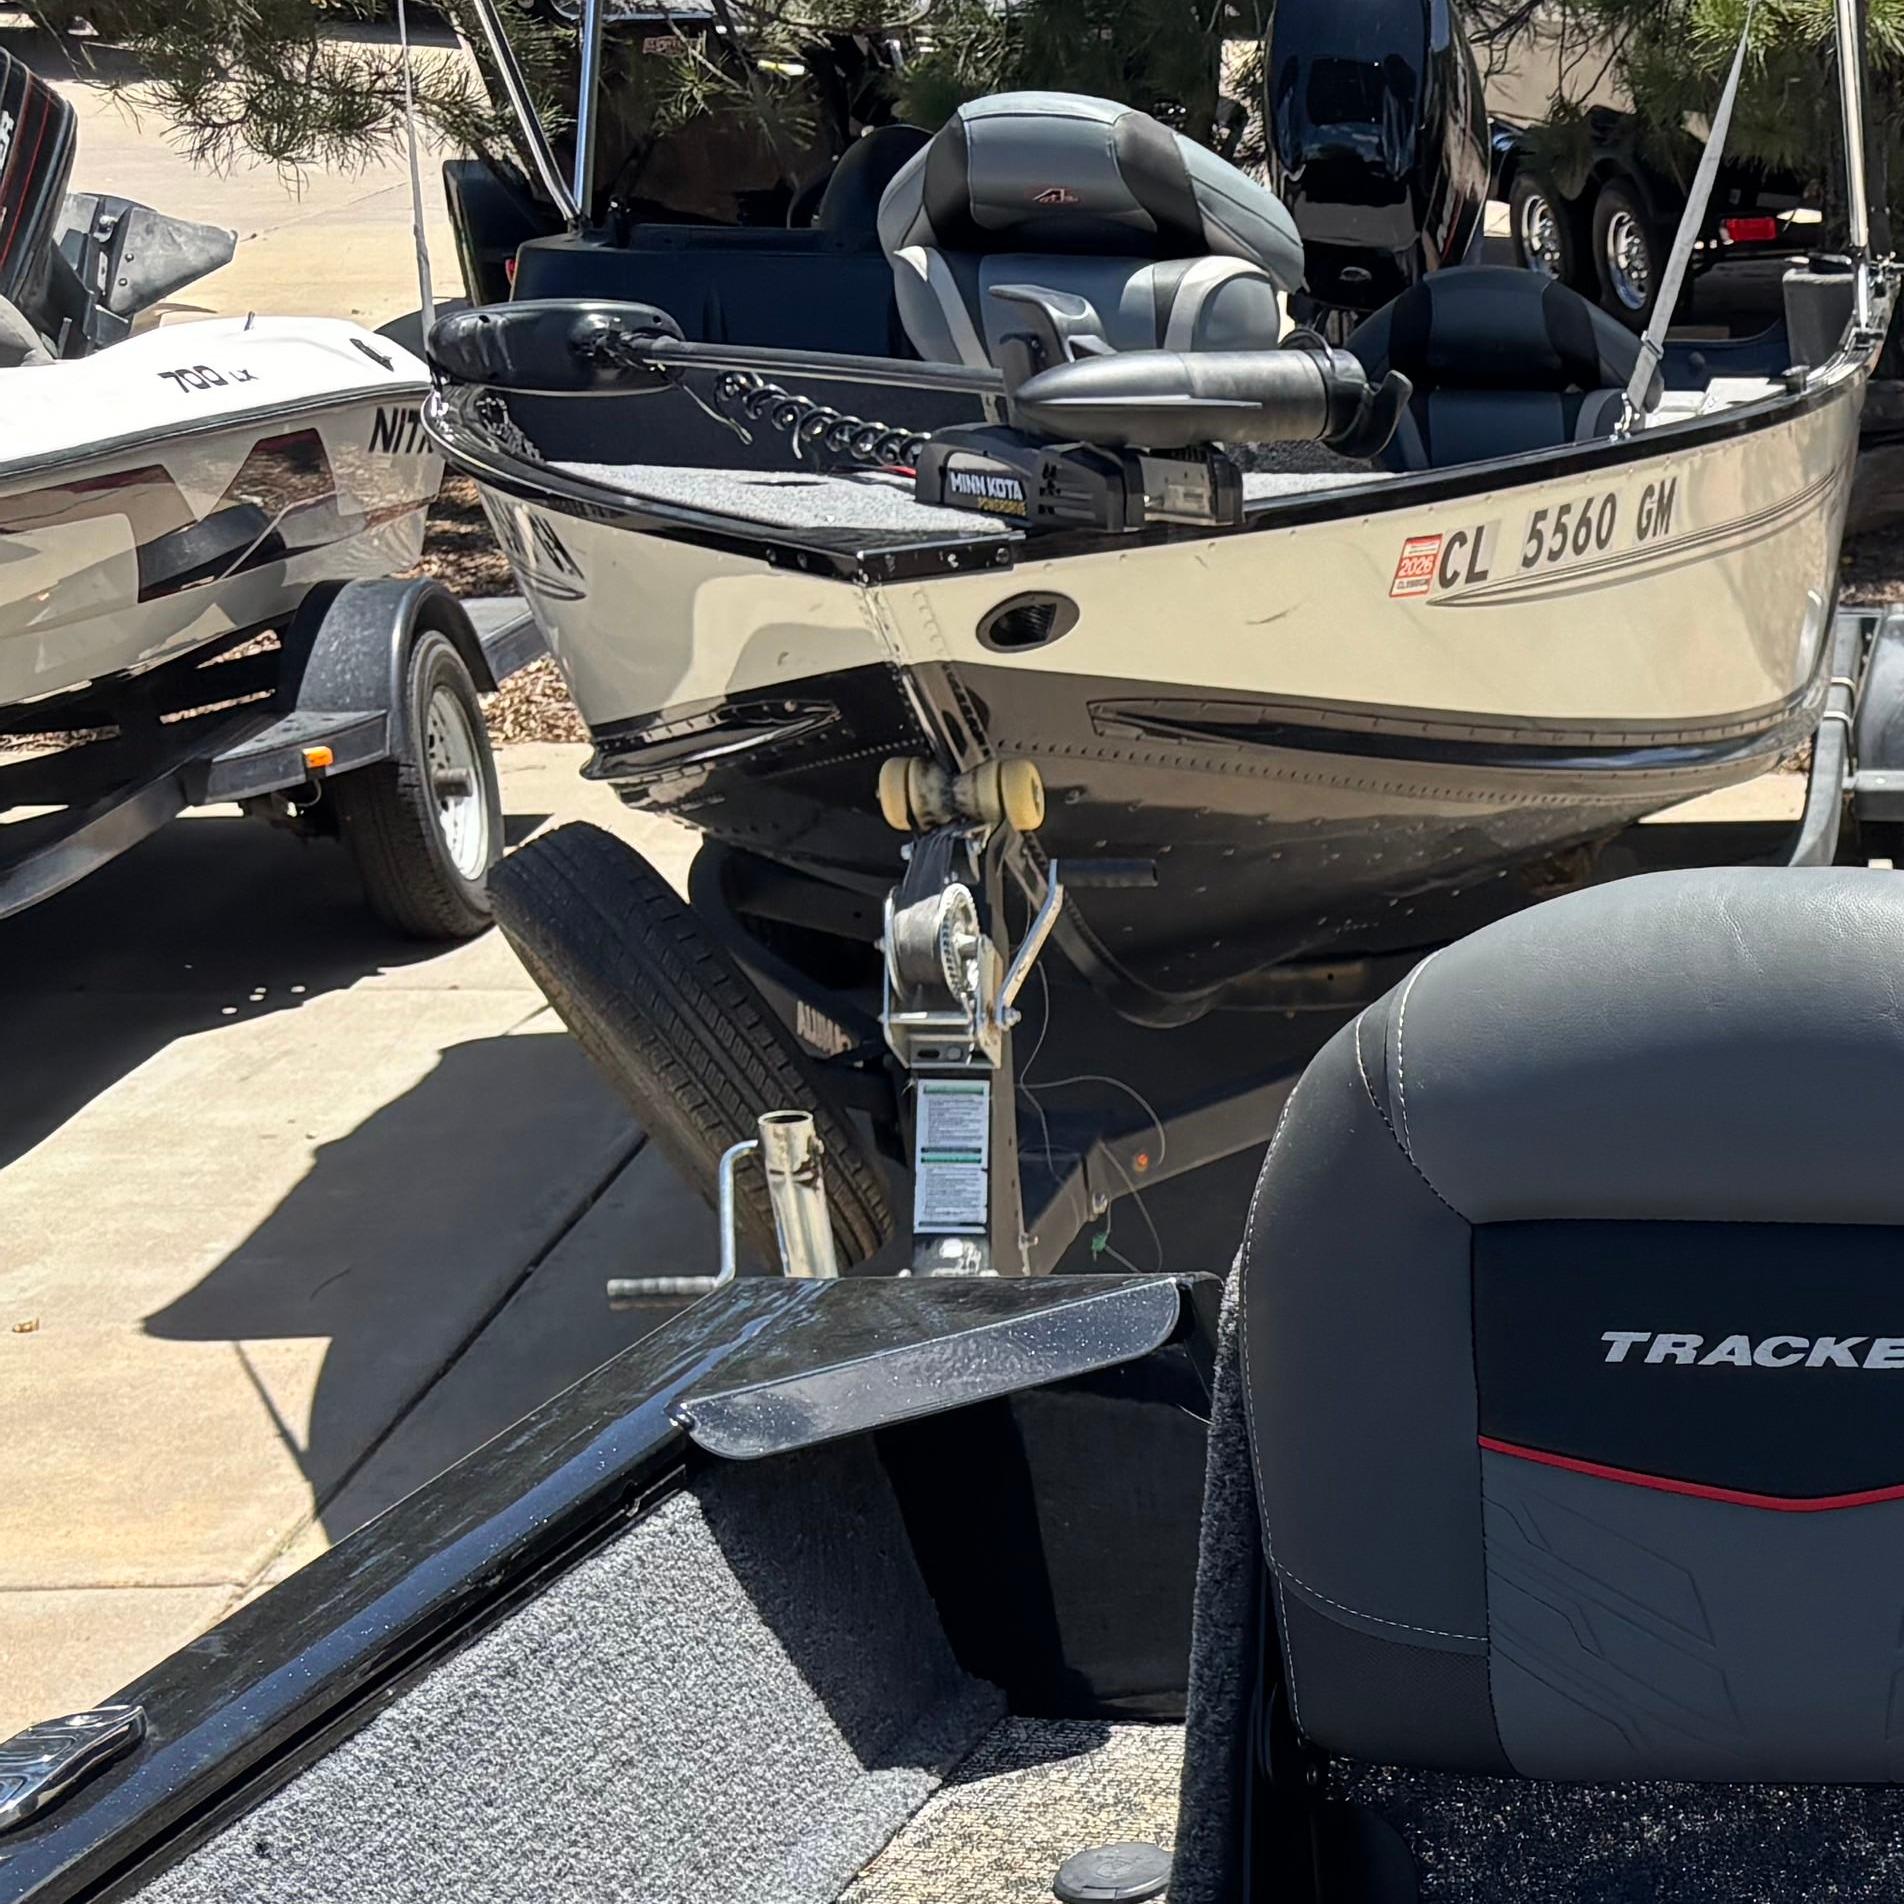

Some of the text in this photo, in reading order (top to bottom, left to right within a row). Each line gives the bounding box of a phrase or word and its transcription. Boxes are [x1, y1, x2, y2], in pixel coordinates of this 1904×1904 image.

[157, 365, 229, 393] 700
[950, 471, 1024, 501] MINN KOTA
[1438, 476, 1677, 589] CL 5560 GM
[1398, 554, 1434, 578] 2026
